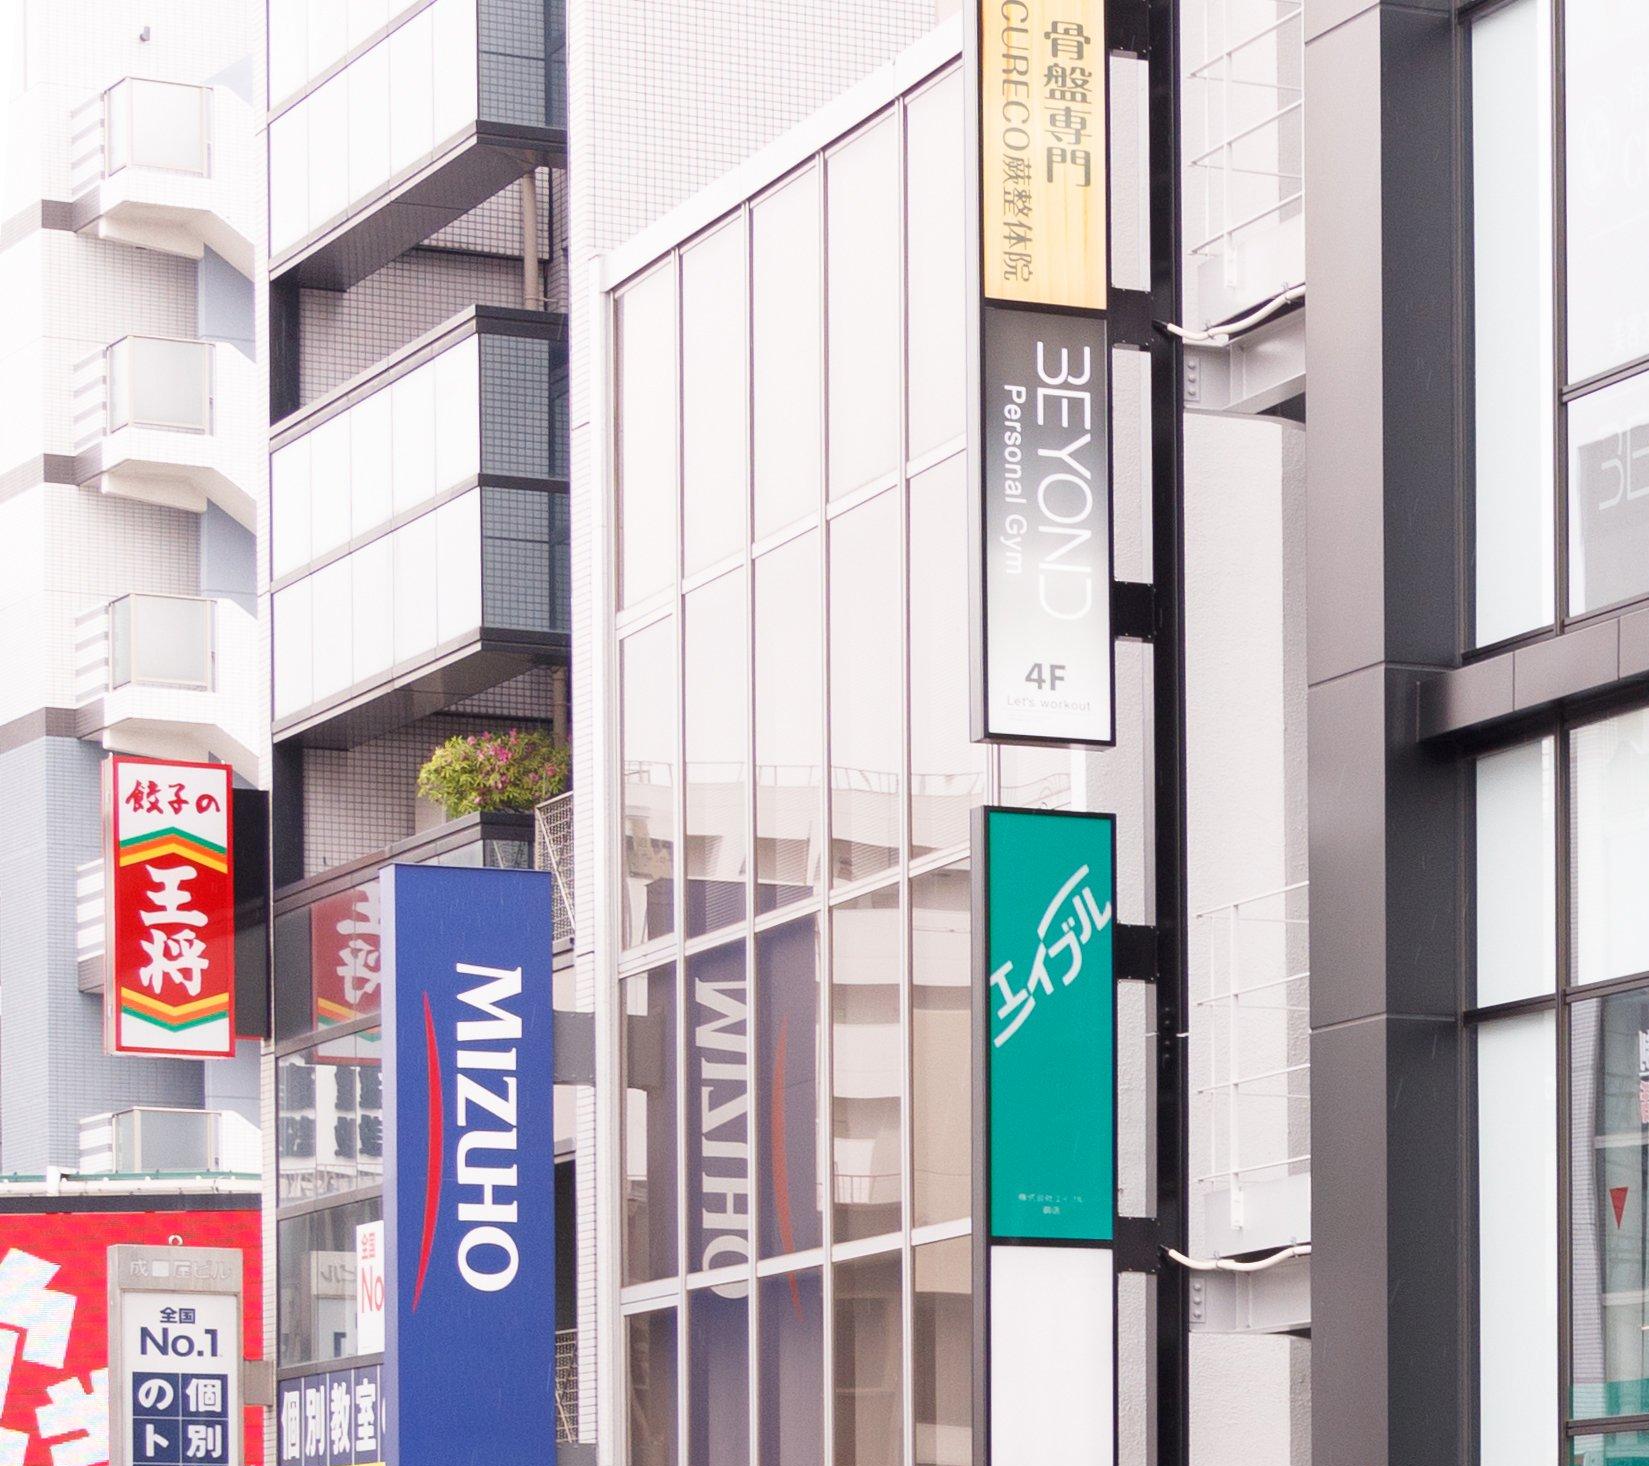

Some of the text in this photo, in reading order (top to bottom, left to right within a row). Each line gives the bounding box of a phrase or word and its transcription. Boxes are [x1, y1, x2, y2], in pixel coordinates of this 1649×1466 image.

[1044, 19, 1092, 188] 骨盤専門
[1000, 384, 1028, 576] Personal Gym
[1024, 662, 1067, 691] 4F
[125, 780, 221, 815] 餃子の
[139, 864, 209, 997] 王将
[990, 864, 1112, 1048] エイブル
[455, 962, 523, 1292] MIZUHO
[140, 1327, 221, 1358] No.1
[159, 1307, 195, 1325] 全国
[281, 1377, 386, 1462] 個別教室
